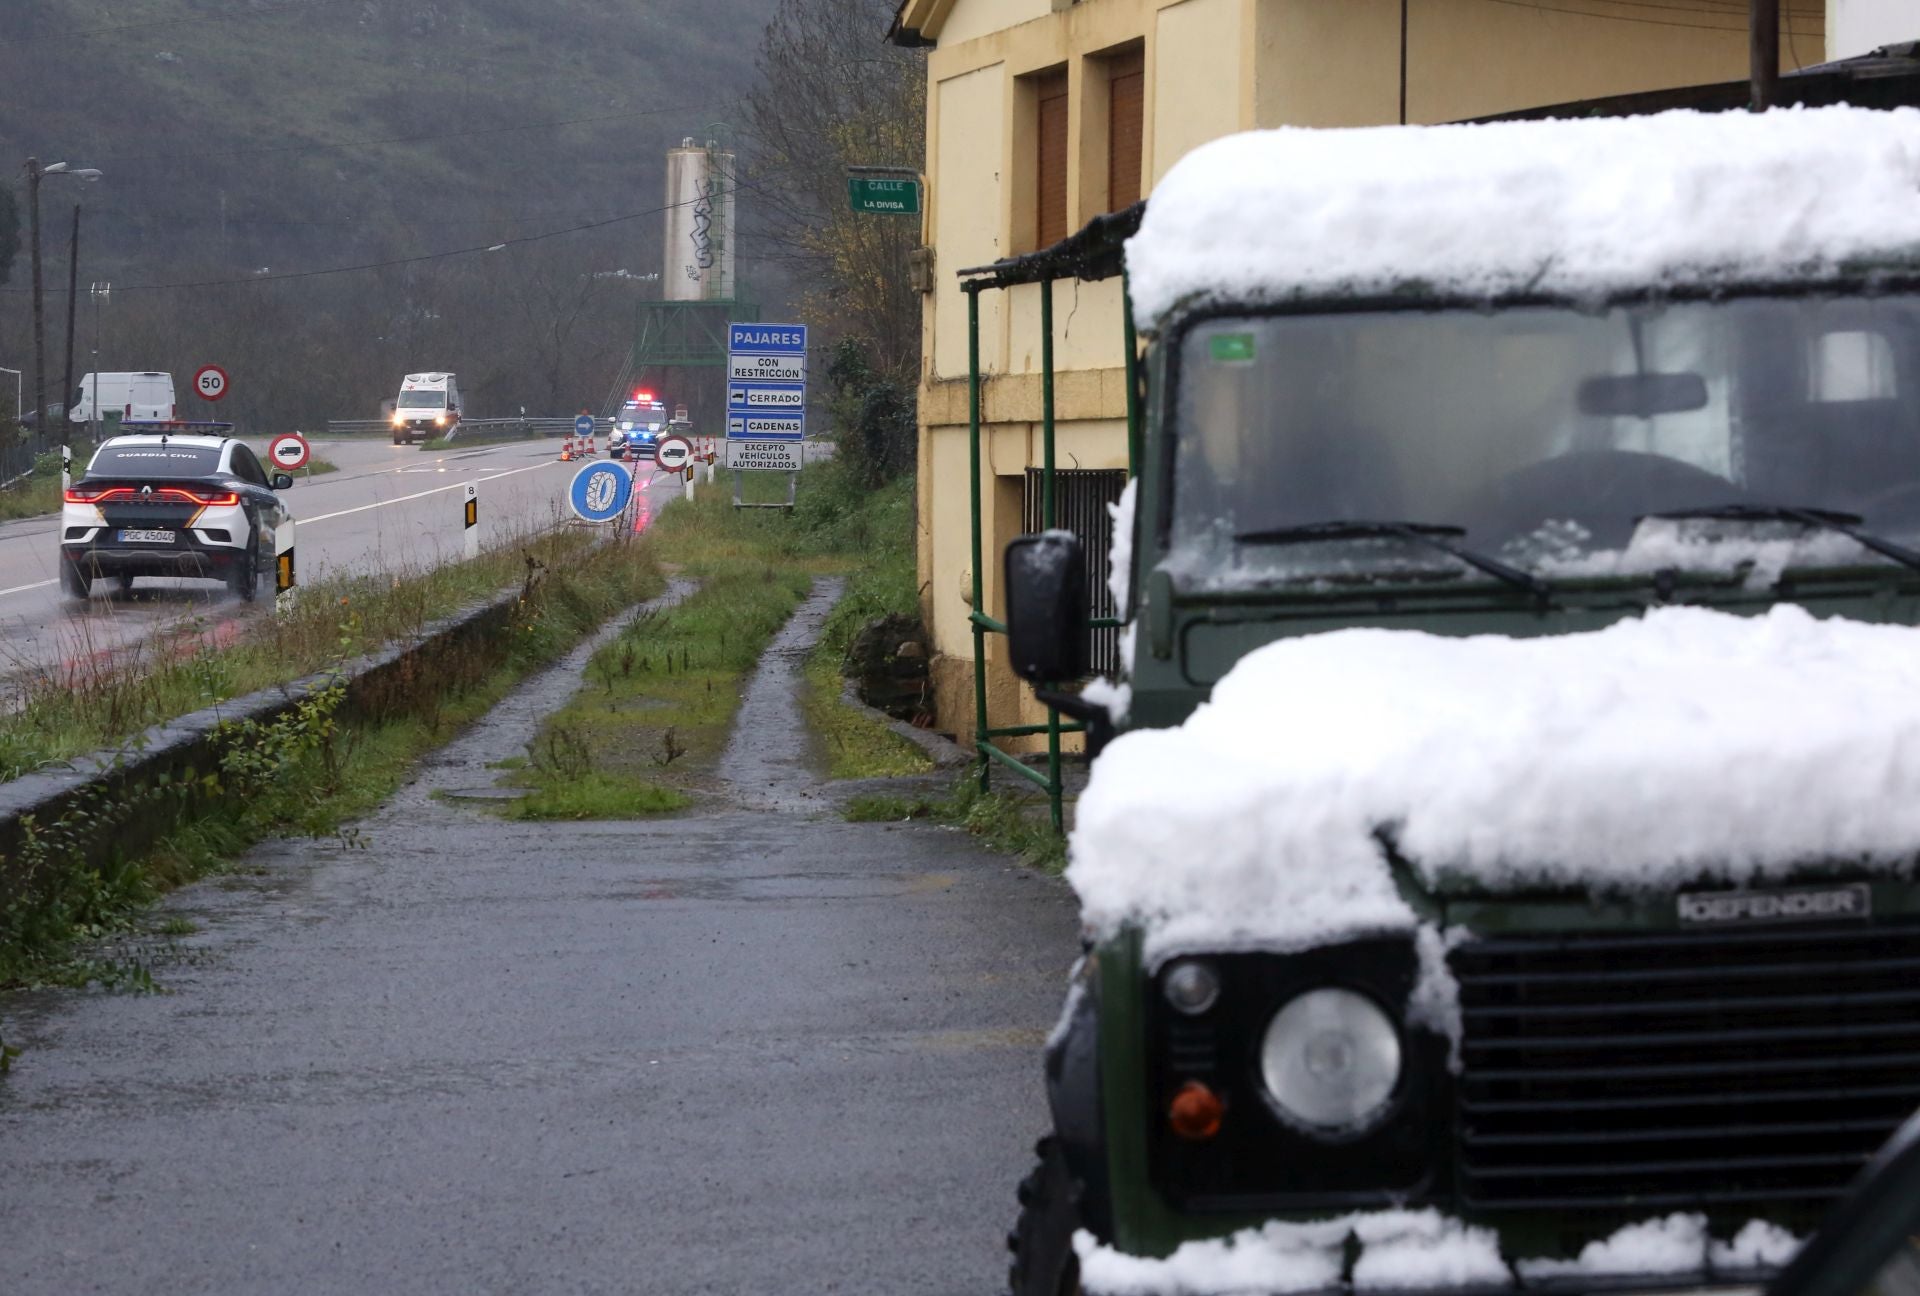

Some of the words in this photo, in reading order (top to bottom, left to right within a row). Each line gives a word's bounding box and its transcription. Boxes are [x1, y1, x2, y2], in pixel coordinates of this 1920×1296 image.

[868, 182, 903, 191] CALLE
[864, 200, 875, 208] LA
[876, 201, 904, 209] DIVISA
[734, 332, 801, 345] PAJARES
[758, 358, 779, 367] CON
[734, 367, 799, 378] RESTRICCIÓN
[201, 377, 221, 389] 50
[749, 394, 801, 403] CERRADO
[748, 422, 800, 431] CADENAS
[744, 444, 786, 452] EXCEPTO
[732, 460, 797, 469] AUTORIZADOS
[468, 486, 475, 495] 8
[124, 530, 142, 540] PGC
